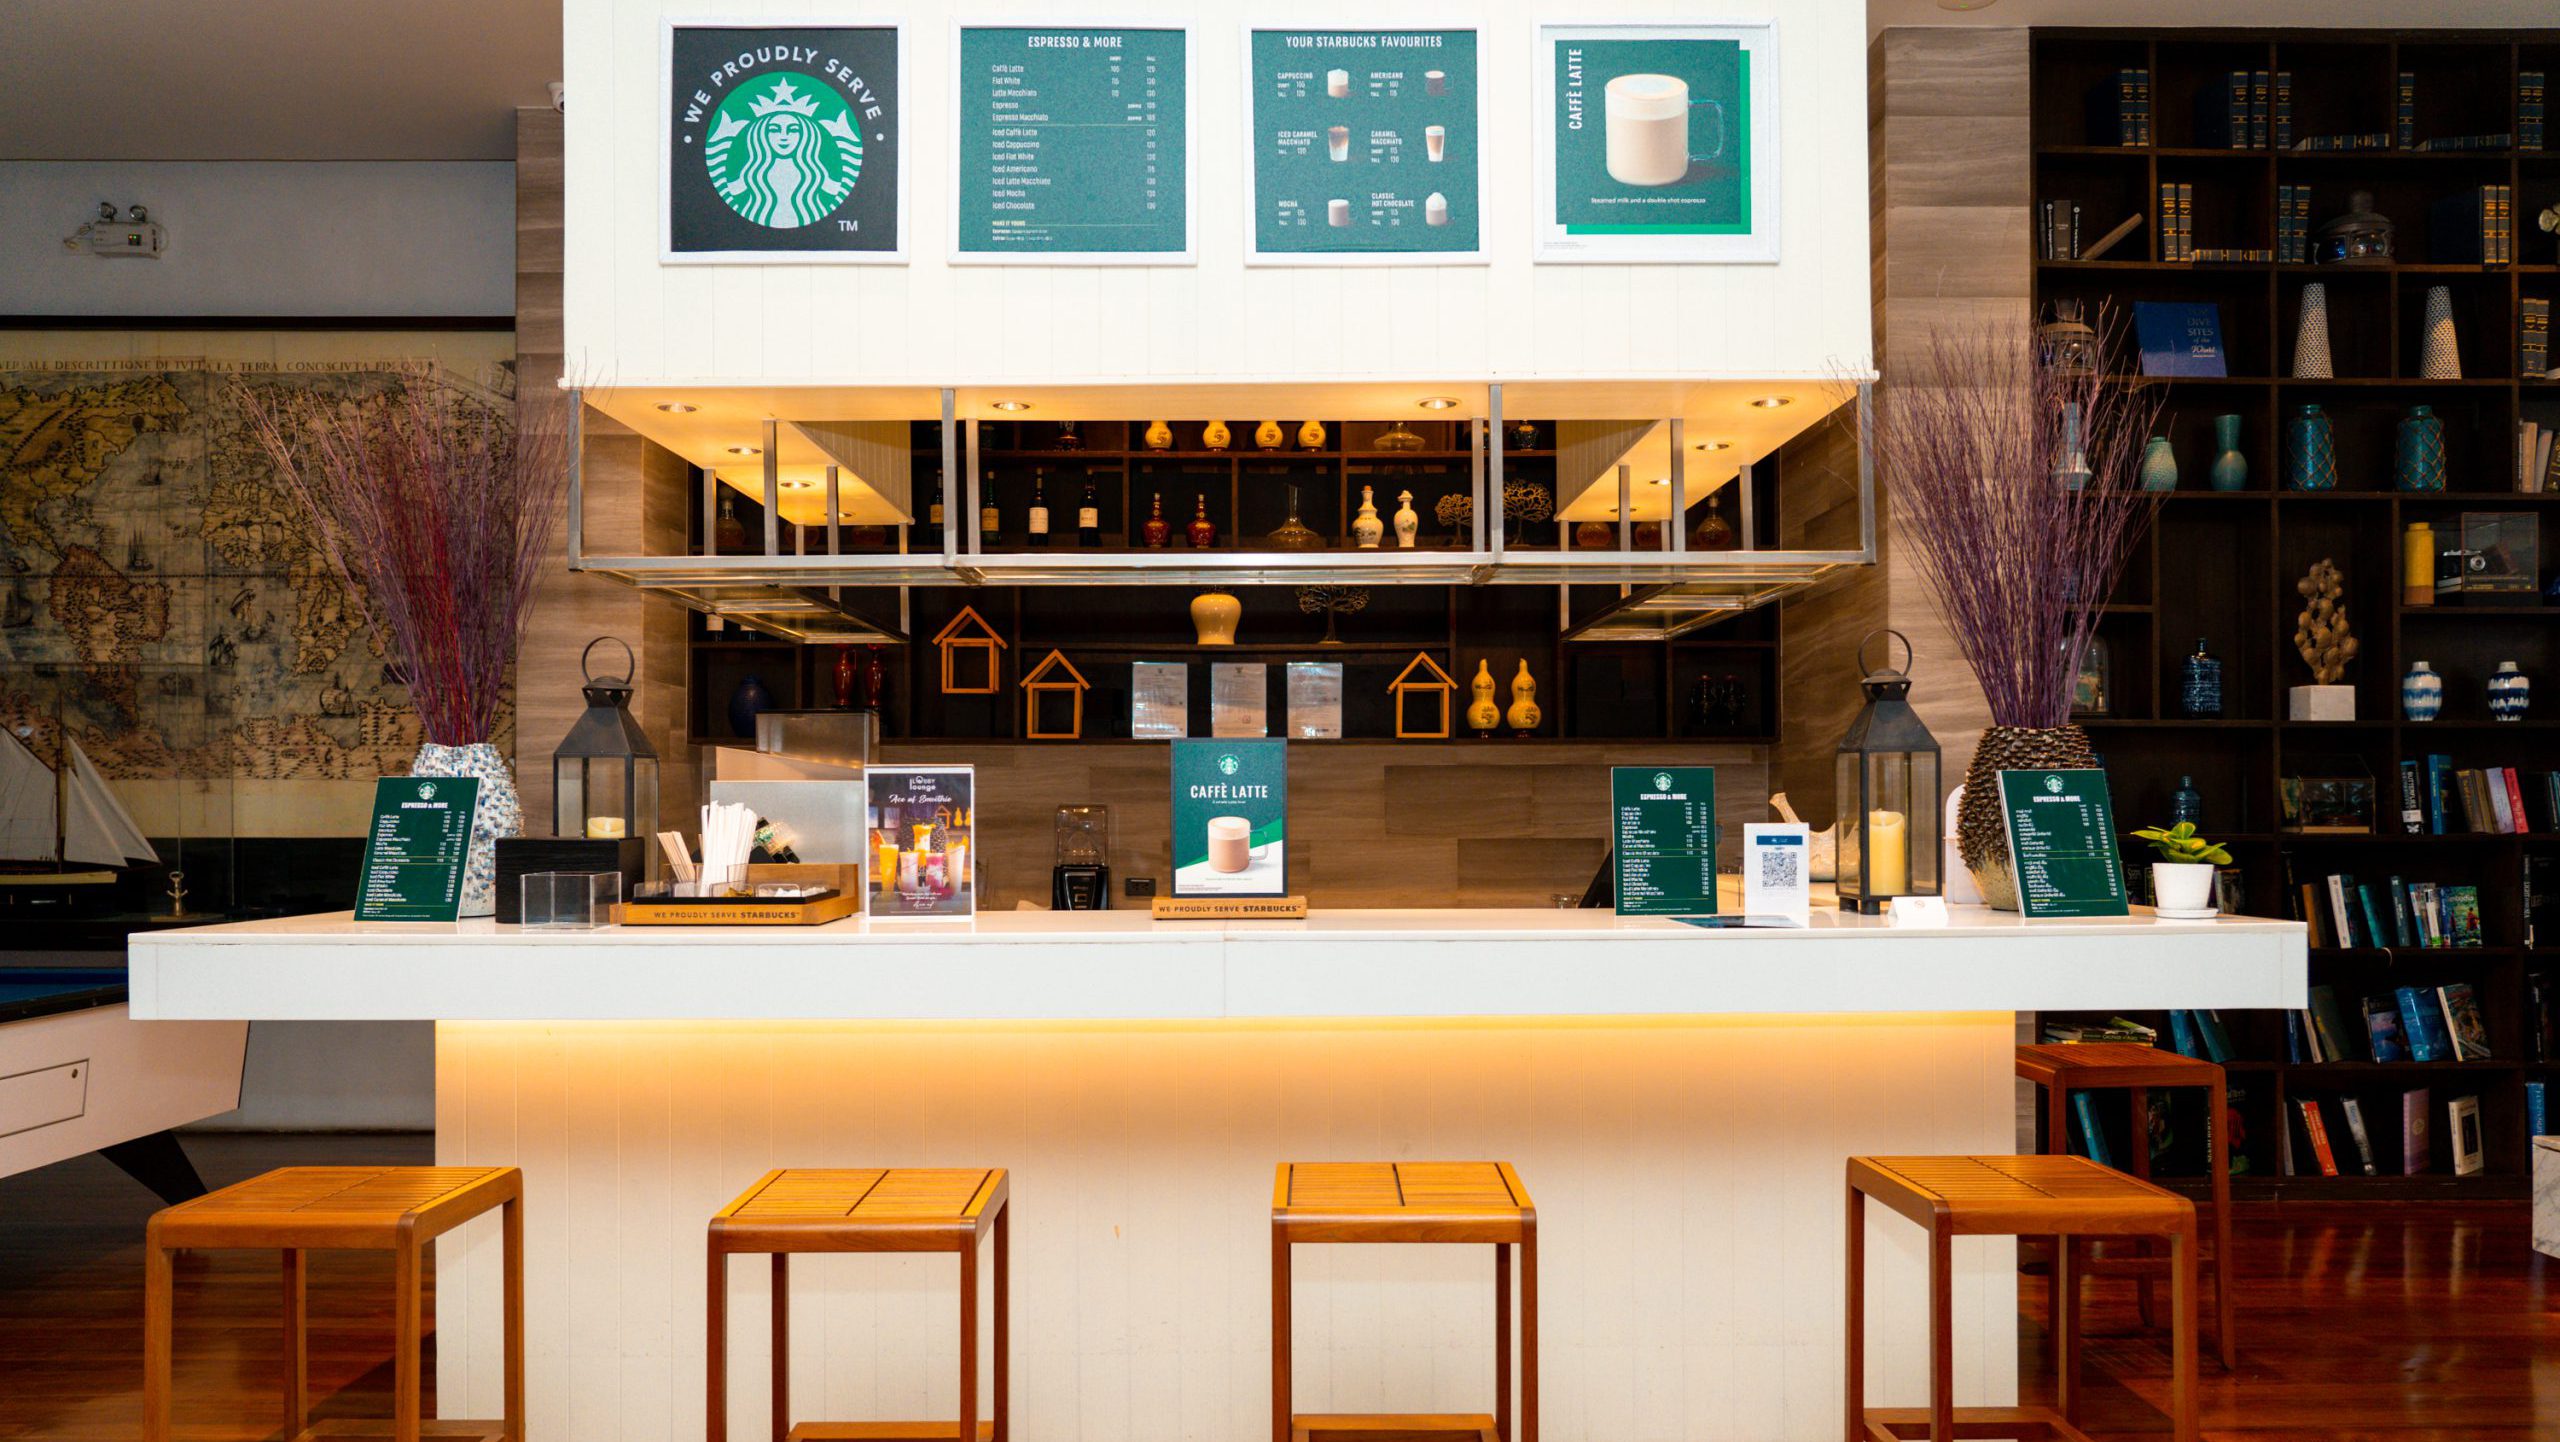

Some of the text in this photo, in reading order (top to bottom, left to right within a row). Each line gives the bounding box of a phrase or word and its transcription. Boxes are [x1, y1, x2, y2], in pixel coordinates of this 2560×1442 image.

[1028, 36, 1123, 48] ESPRESSO & MORE
[1285, 36, 1443, 48] YOUR STARBUCKS FAVOURITES
[1277, 72, 1313, 80] CAPPUCCINO
[684, 45, 882, 124] WE PROUDLY SERVE
[1003, 77, 1021, 85] White
[1566, 48, 1583, 131] CAFFÈ LATTE
[992, 102, 1019, 110] Espresso
[992, 114, 1018, 122] Espresso
[1019, 113, 1049, 121] Macchiato
[992, 128, 1005, 137] Iced
[992, 141, 1005, 149] Iced
[992, 153, 1005, 161] Iced
[992, 165, 1005, 173] Iced
[1006, 165, 1038, 173] Americano
[992, 177, 1005, 185] Iced
[992, 202, 1005, 210] Iced
[1006, 202, 1035, 210] Chocolate
[838, 220, 858, 232] TM
[2187, 318, 2212, 327] DIVE
[2187, 327, 2214, 337] SITES
[1190, 782, 1269, 799] CAFFÈ LATTE
[1174, 905, 1211, 913] PROUDLY
[670, 911, 708, 919] PROUDLY
[711, 911, 737, 919] SERVE
[740, 911, 796, 919] STARBUCKS
